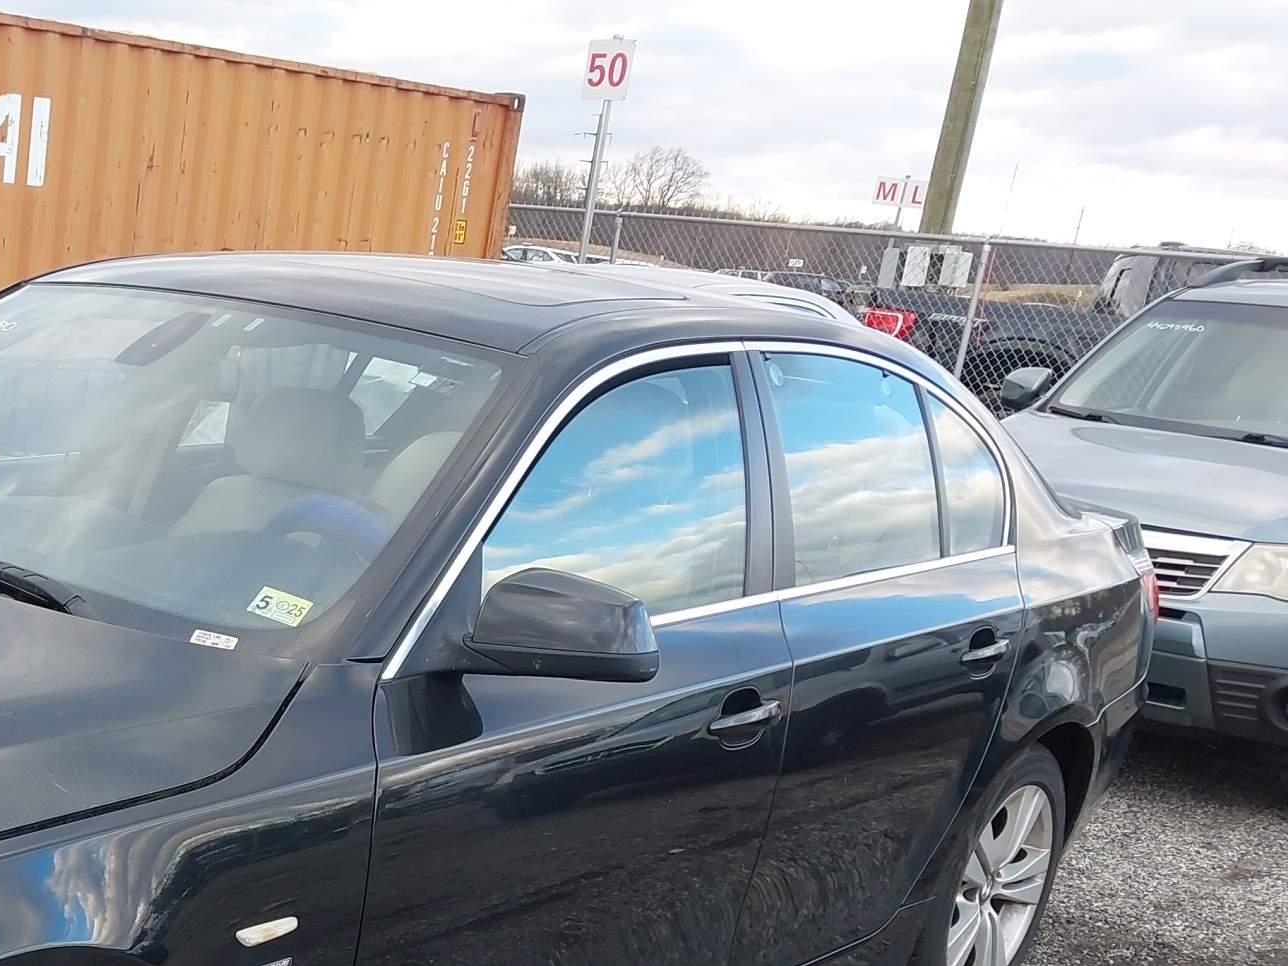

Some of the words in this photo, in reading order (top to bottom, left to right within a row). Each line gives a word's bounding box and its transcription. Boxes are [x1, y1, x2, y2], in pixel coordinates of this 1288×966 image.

[587, 52, 628, 88] 50
[434, 141, 450, 212] CAIU
[460, 144, 475, 214] 22G1
[875, 181, 899, 202] M
[911, 185, 923, 205] L
[428, 216, 440, 257] 21
[255, 594, 274, 610] 5
[286, 603, 307, 618] 25
